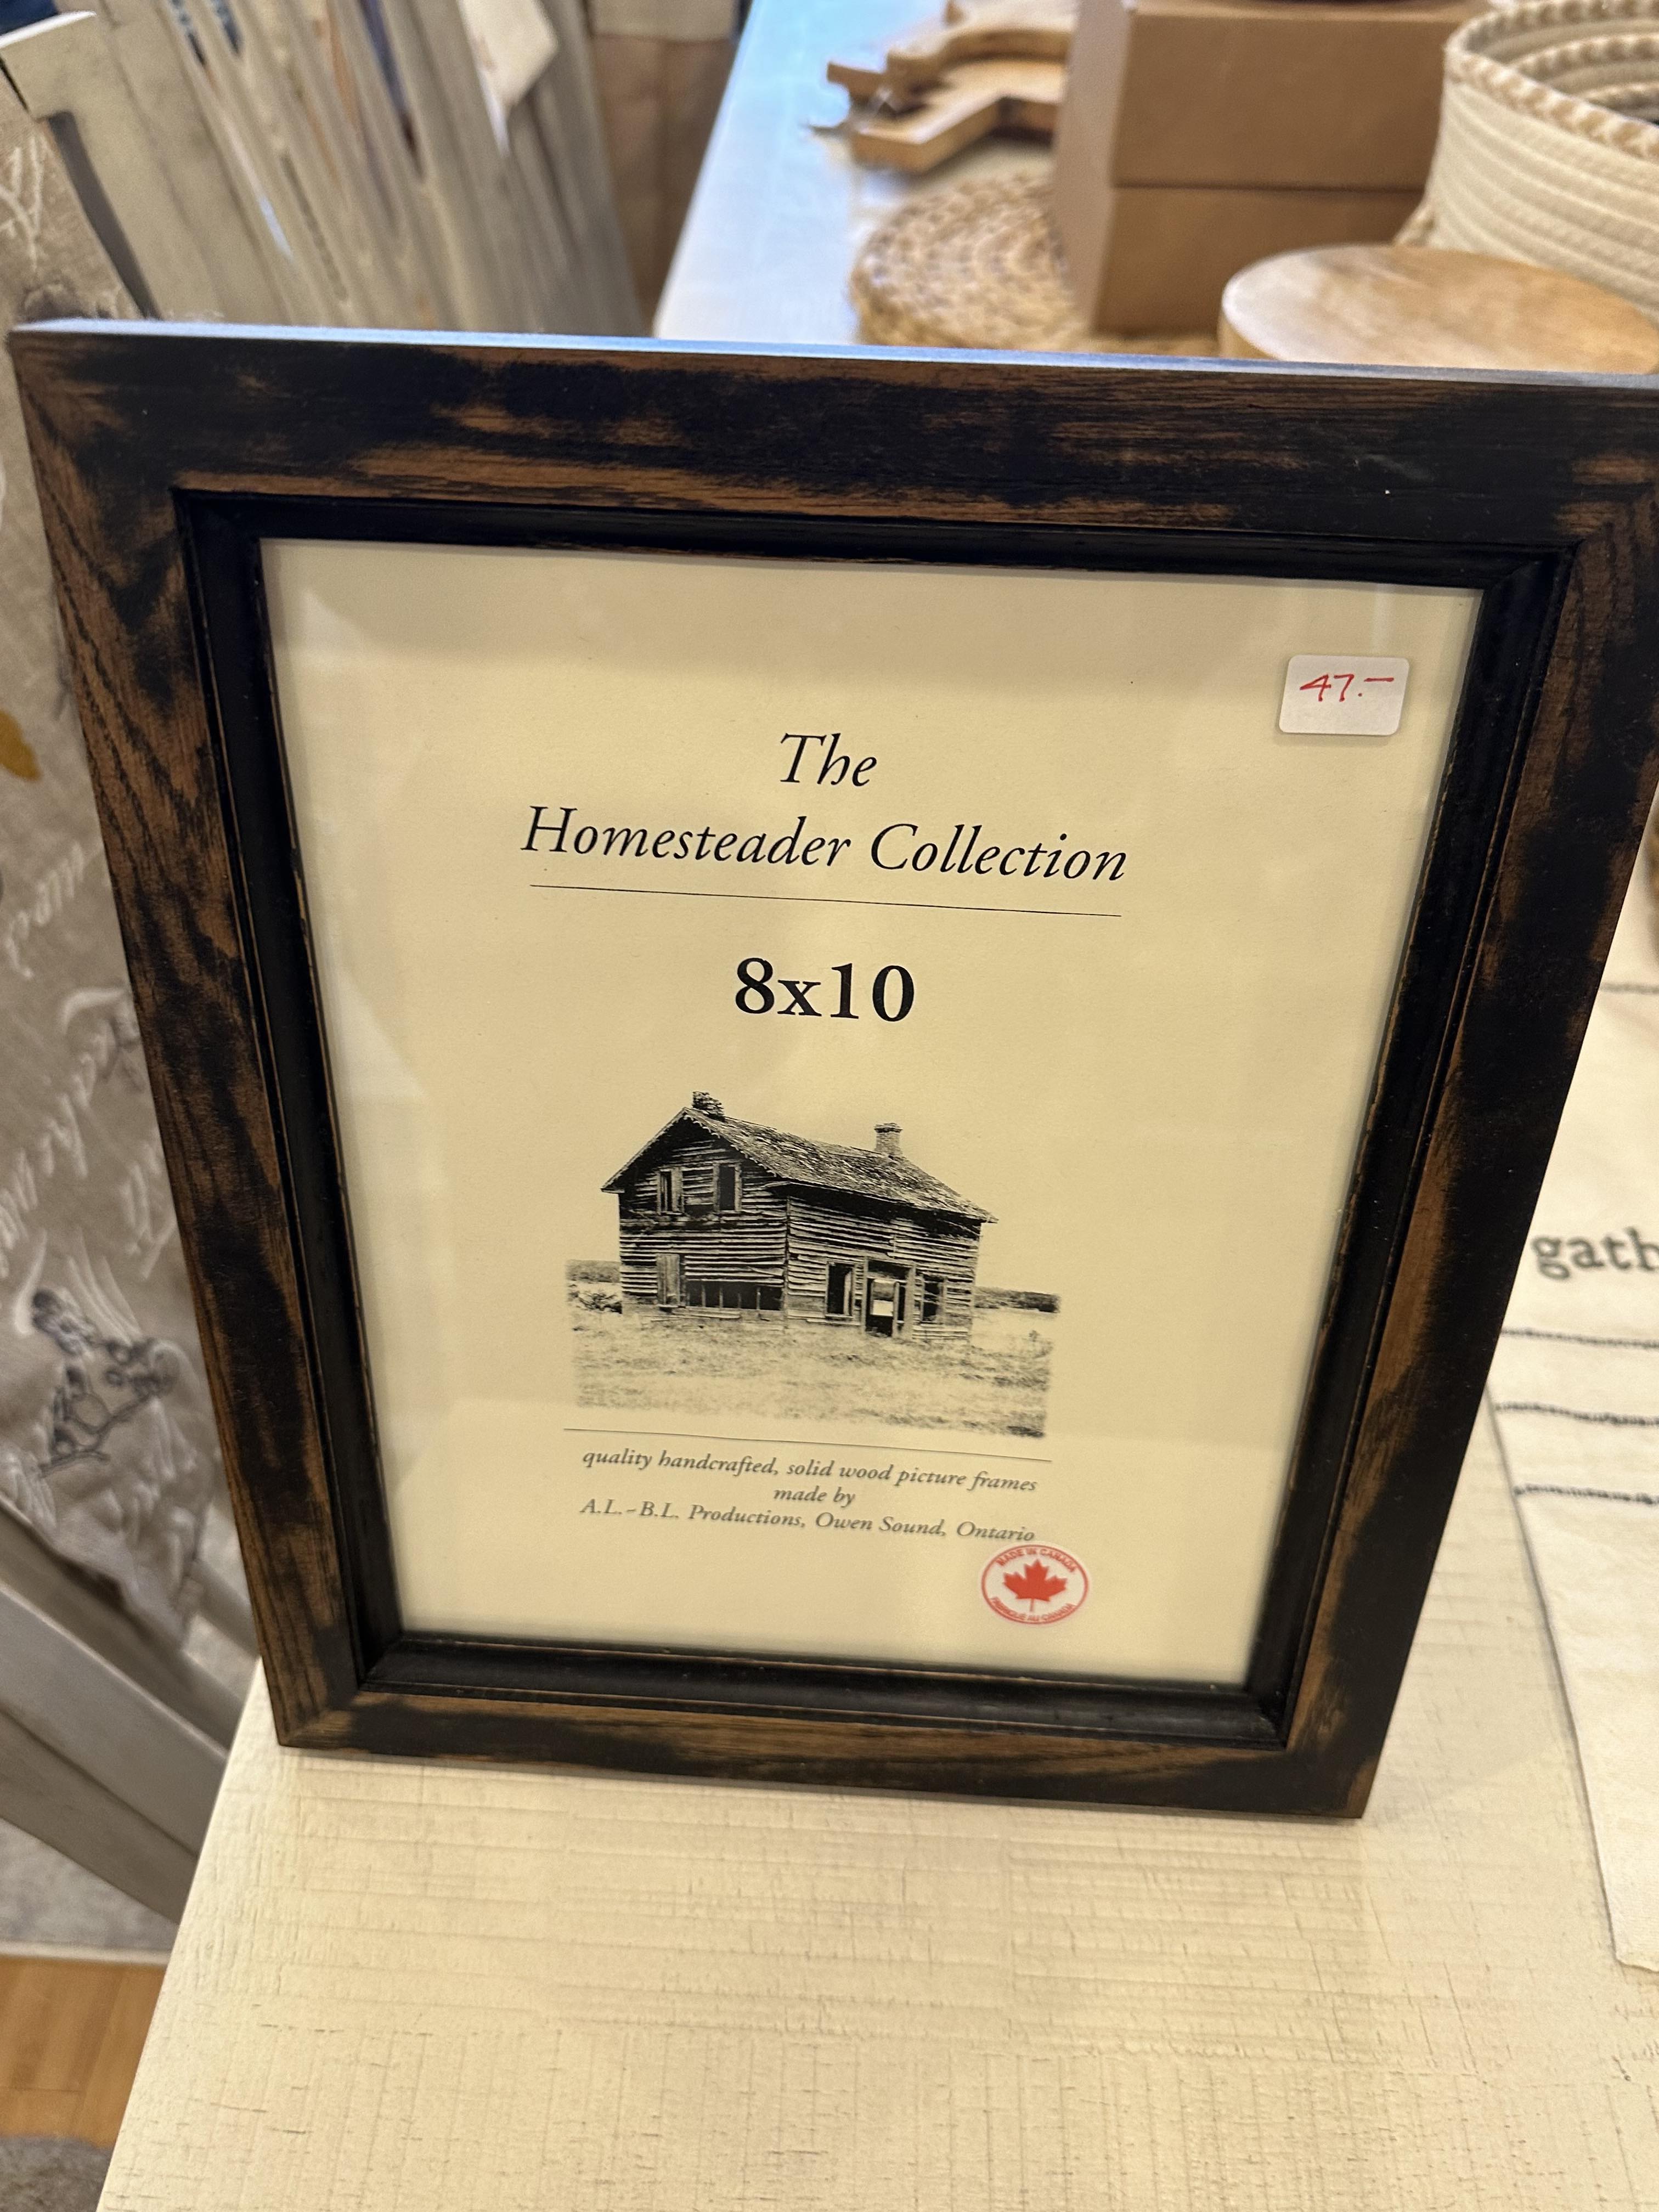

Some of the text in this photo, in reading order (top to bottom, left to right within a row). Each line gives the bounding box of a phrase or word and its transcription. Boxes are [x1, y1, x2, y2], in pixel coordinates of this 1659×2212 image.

[780, 732, 878, 787] The
[521, 805, 1128, 882] Homesteader Collection
[735, 957, 915, 1022] 8x10
[582, 1448, 1037, 1492] quality handcrafted, solid wood picture frames
[773, 1485, 855, 1508] made by
[688, 1504, 806, 1528] Productions,
[815, 1512, 873, 1531] Owen
[878, 1516, 947, 1537] Sound,
[956, 1521, 1035, 1542] Ontario
[996, 1549, 1024, 1566] MADE
[1040, 1549, 1075, 1572] CANADA
